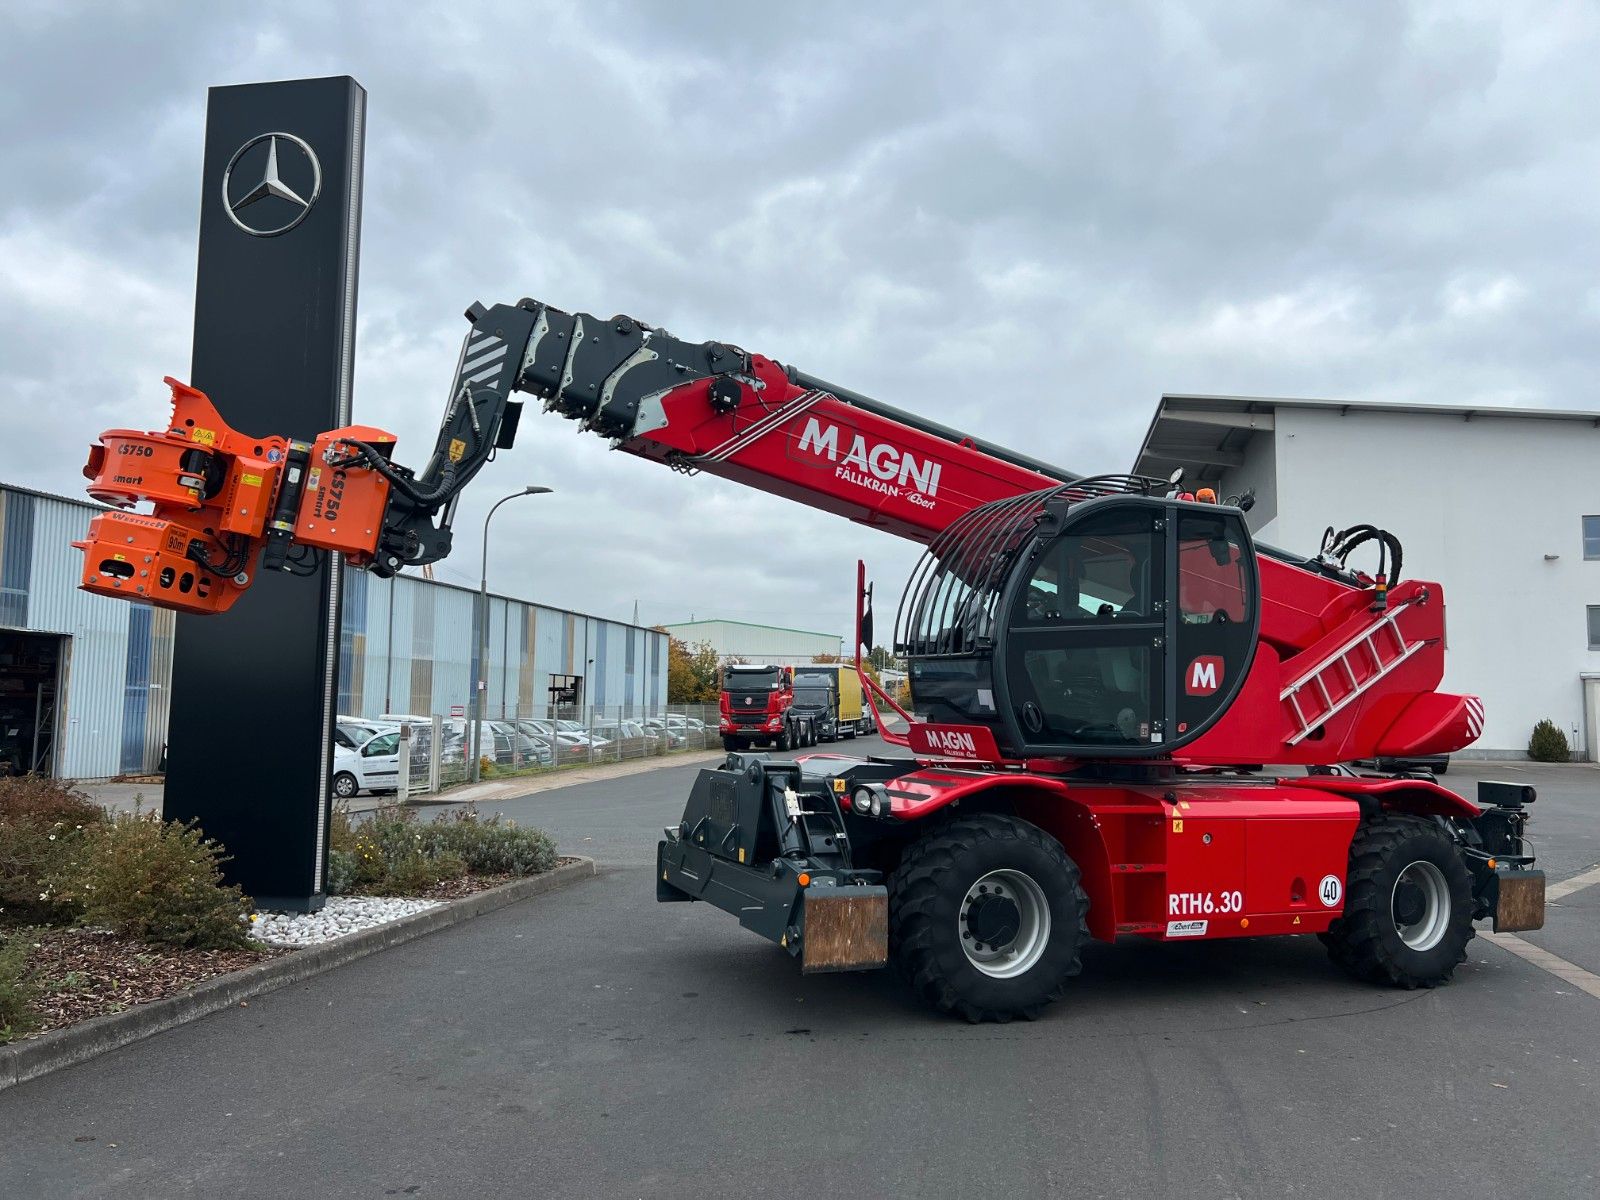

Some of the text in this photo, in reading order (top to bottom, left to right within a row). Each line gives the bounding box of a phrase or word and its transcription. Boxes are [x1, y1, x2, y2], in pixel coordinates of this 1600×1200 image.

[798, 417, 942, 497] MAGNI
[113, 475, 143, 485] smart
[313, 486, 326, 518] smart
[324, 470, 347, 521] CS750
[1192, 662, 1217, 689] M
[925, 730, 976, 751] MAGNI
[1169, 890, 1242, 915] RTH6.30
[1323, 881, 1337, 900] 40
